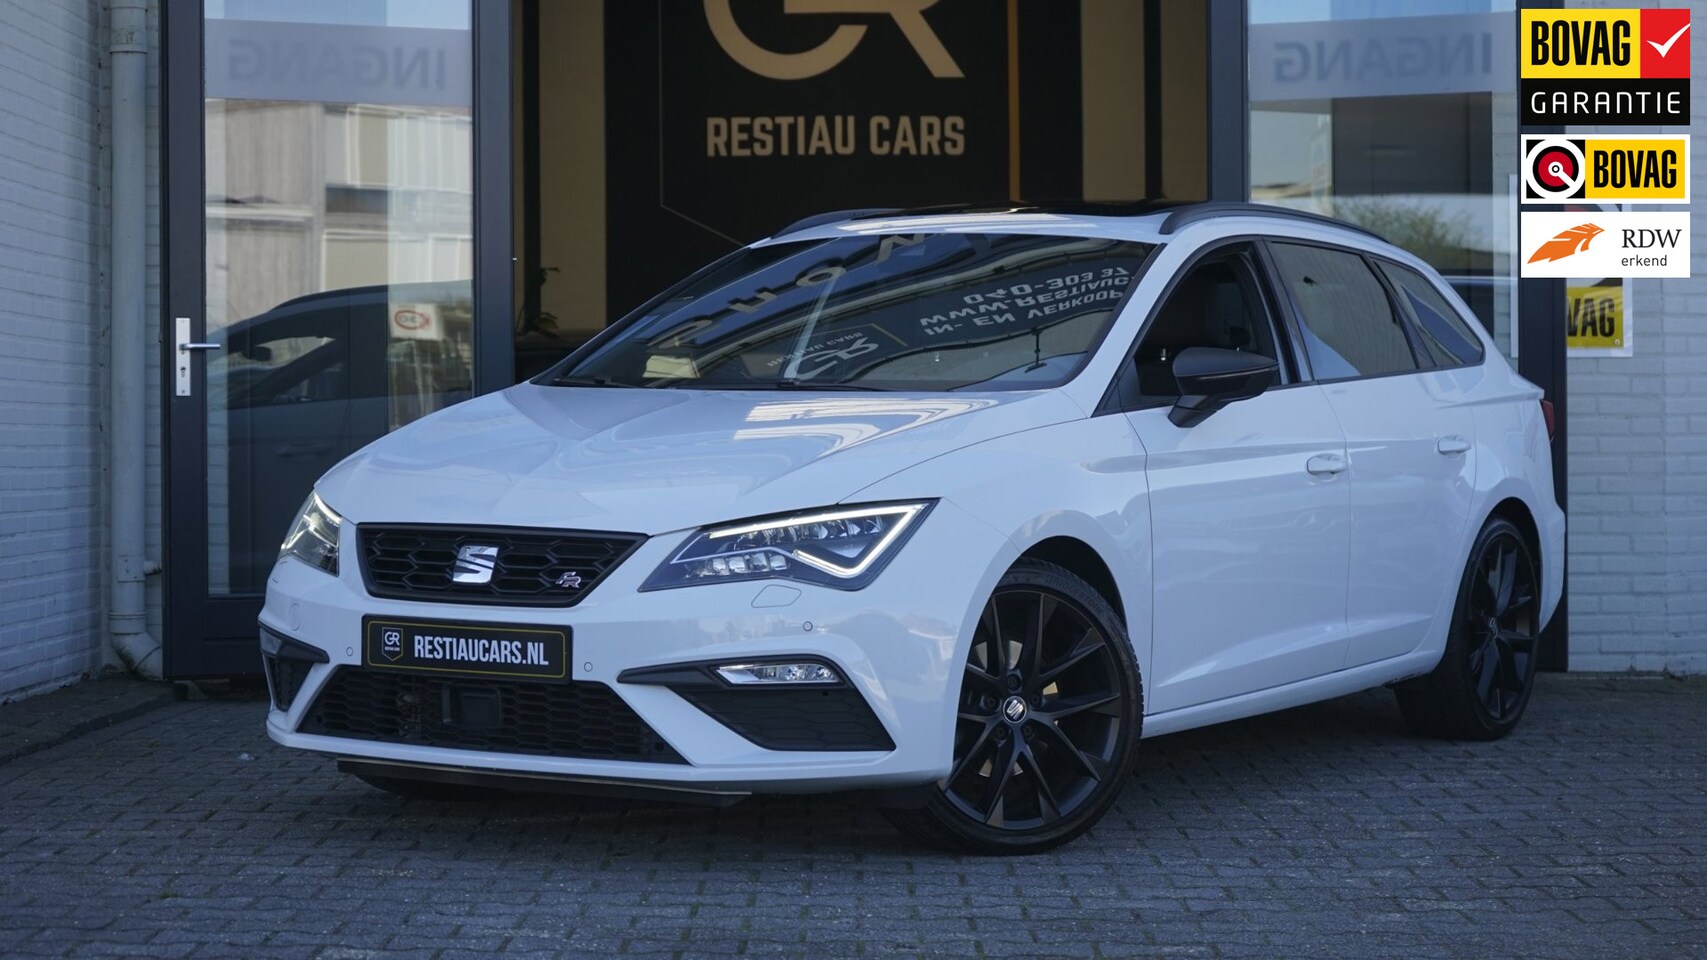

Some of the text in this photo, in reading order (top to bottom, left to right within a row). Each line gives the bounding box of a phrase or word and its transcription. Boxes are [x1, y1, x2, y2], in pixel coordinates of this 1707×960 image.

[706, 115, 966, 157] RESTIAU CARS
[384, 631, 400, 646] GR
[413, 634, 549, 666] RESTIAUCARS.NL
